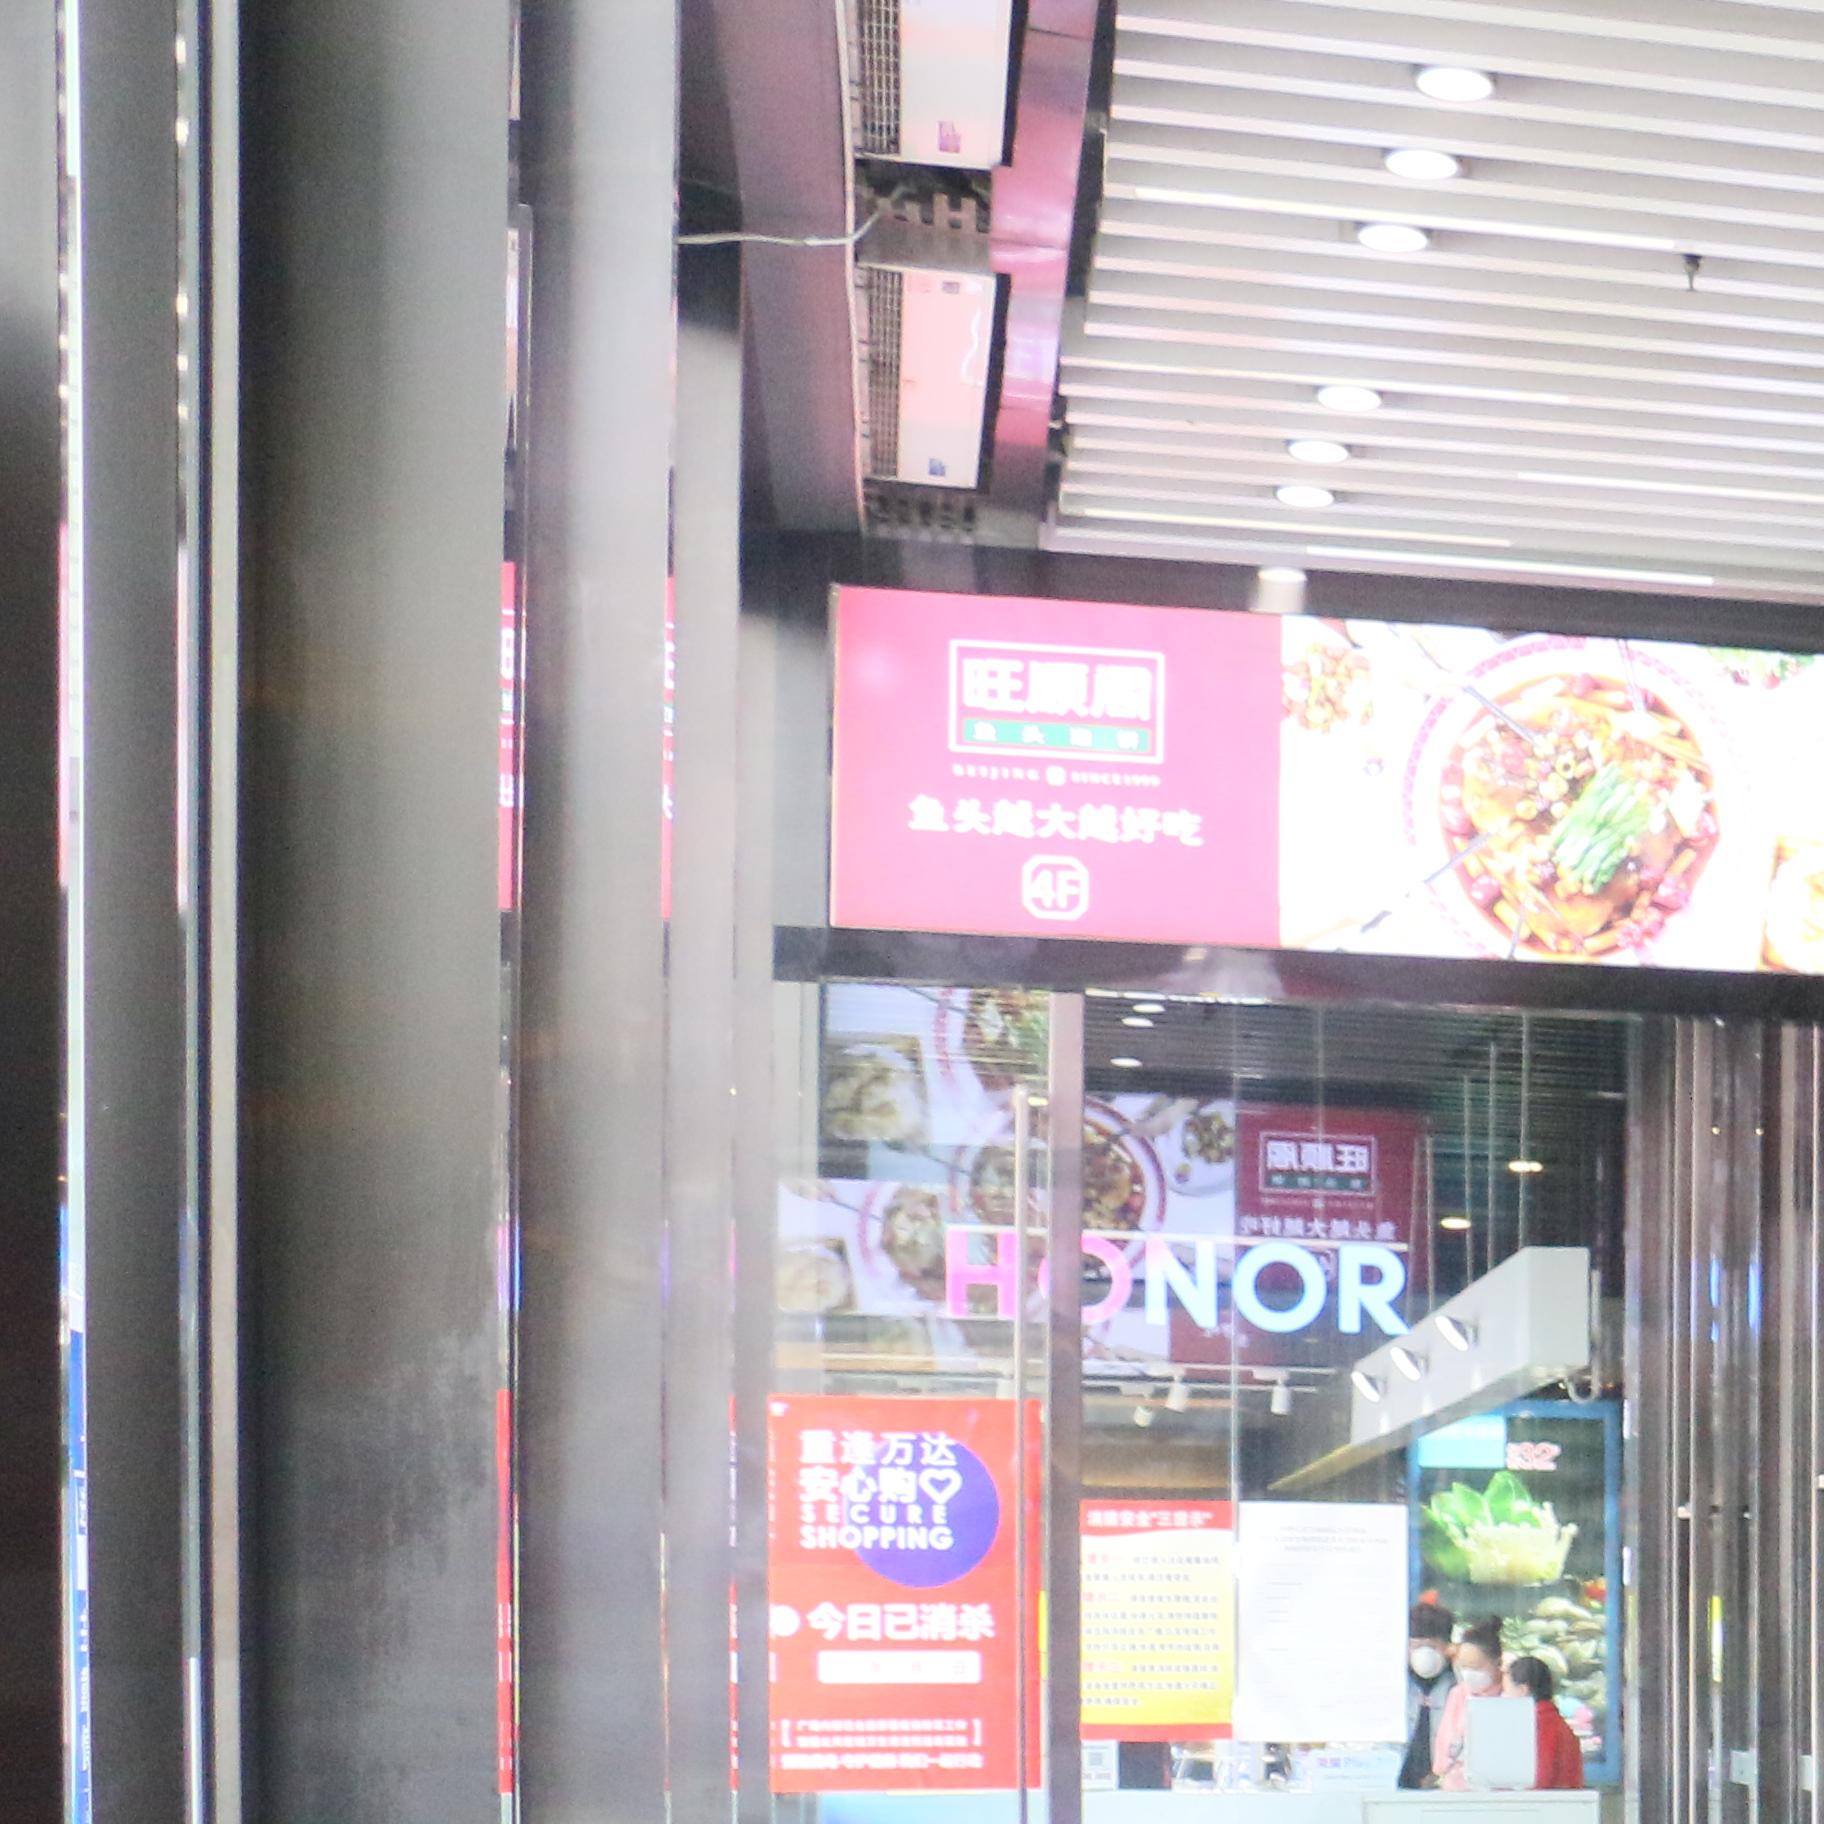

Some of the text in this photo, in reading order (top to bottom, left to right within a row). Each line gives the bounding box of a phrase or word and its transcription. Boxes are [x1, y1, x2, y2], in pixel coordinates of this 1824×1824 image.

[908, 794, 1205, 847] 鱼头越大越好吃
[1030, 869, 1082, 909] 4F
[945, 1230, 1411, 1336] HONOR
[800, 1430, 958, 1467] 重逢万达
[800, 1466, 917, 1502] 安心购
[800, 1504, 947, 1524] SECURE
[799, 1525, 954, 1550] SHOPPING
[806, 1602, 995, 1641] 今日已消杀
